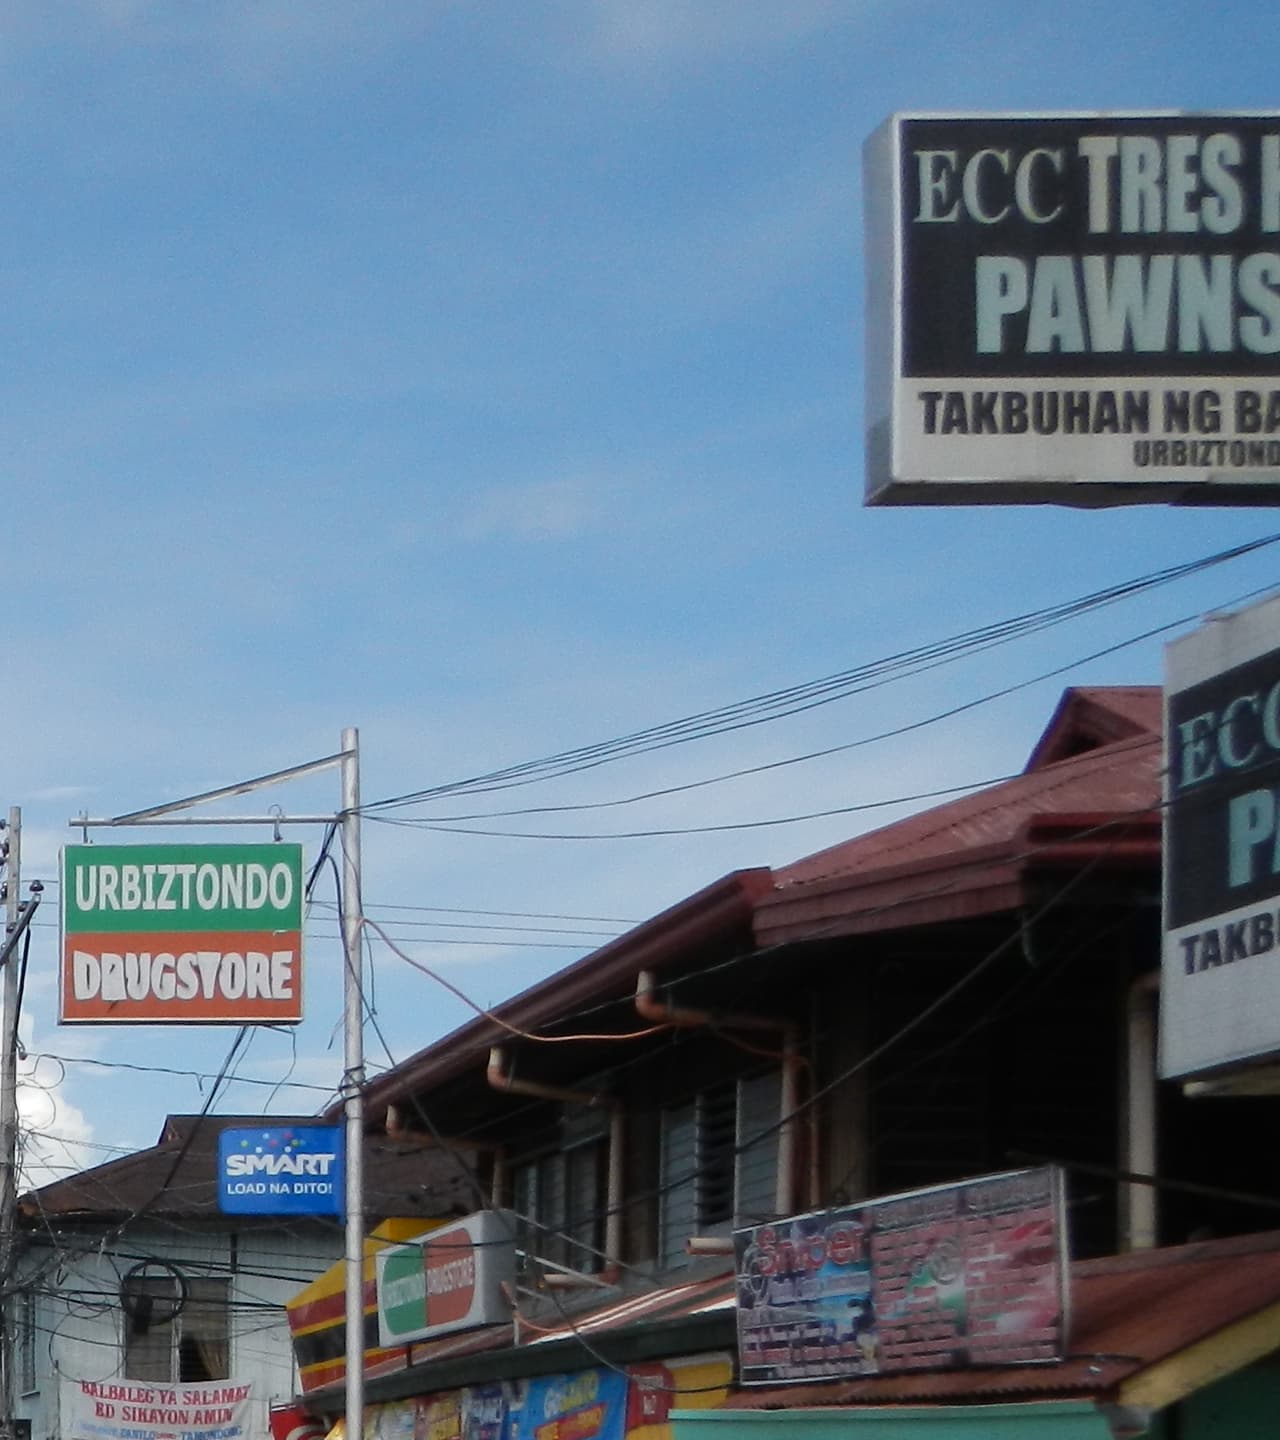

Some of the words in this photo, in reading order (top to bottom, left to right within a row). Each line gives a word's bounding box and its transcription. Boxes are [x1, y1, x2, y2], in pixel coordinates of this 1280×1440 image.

[913, 149, 1066, 225] ECC
[1078, 133, 1243, 235] TRES
[975, 252, 1280, 355] PAWNS
[918, 390, 1150, 435] TAKBUHAN
[1163, 390, 1222, 434] NG
[75, 863, 293, 911] URBIZTONDO
[1179, 909, 1280, 976] TAKB
[72, 950, 294, 1000] DRUGSTORE
[226, 1153, 336, 1177] SMART
[227, 1183, 266, 1195] LOAD
[269, 1183, 290, 1195] NA
[294, 1182, 333, 1195] DITO!
[159, 1390, 177, 1405] YA
[193, 1408, 233, 1425] AMIN
